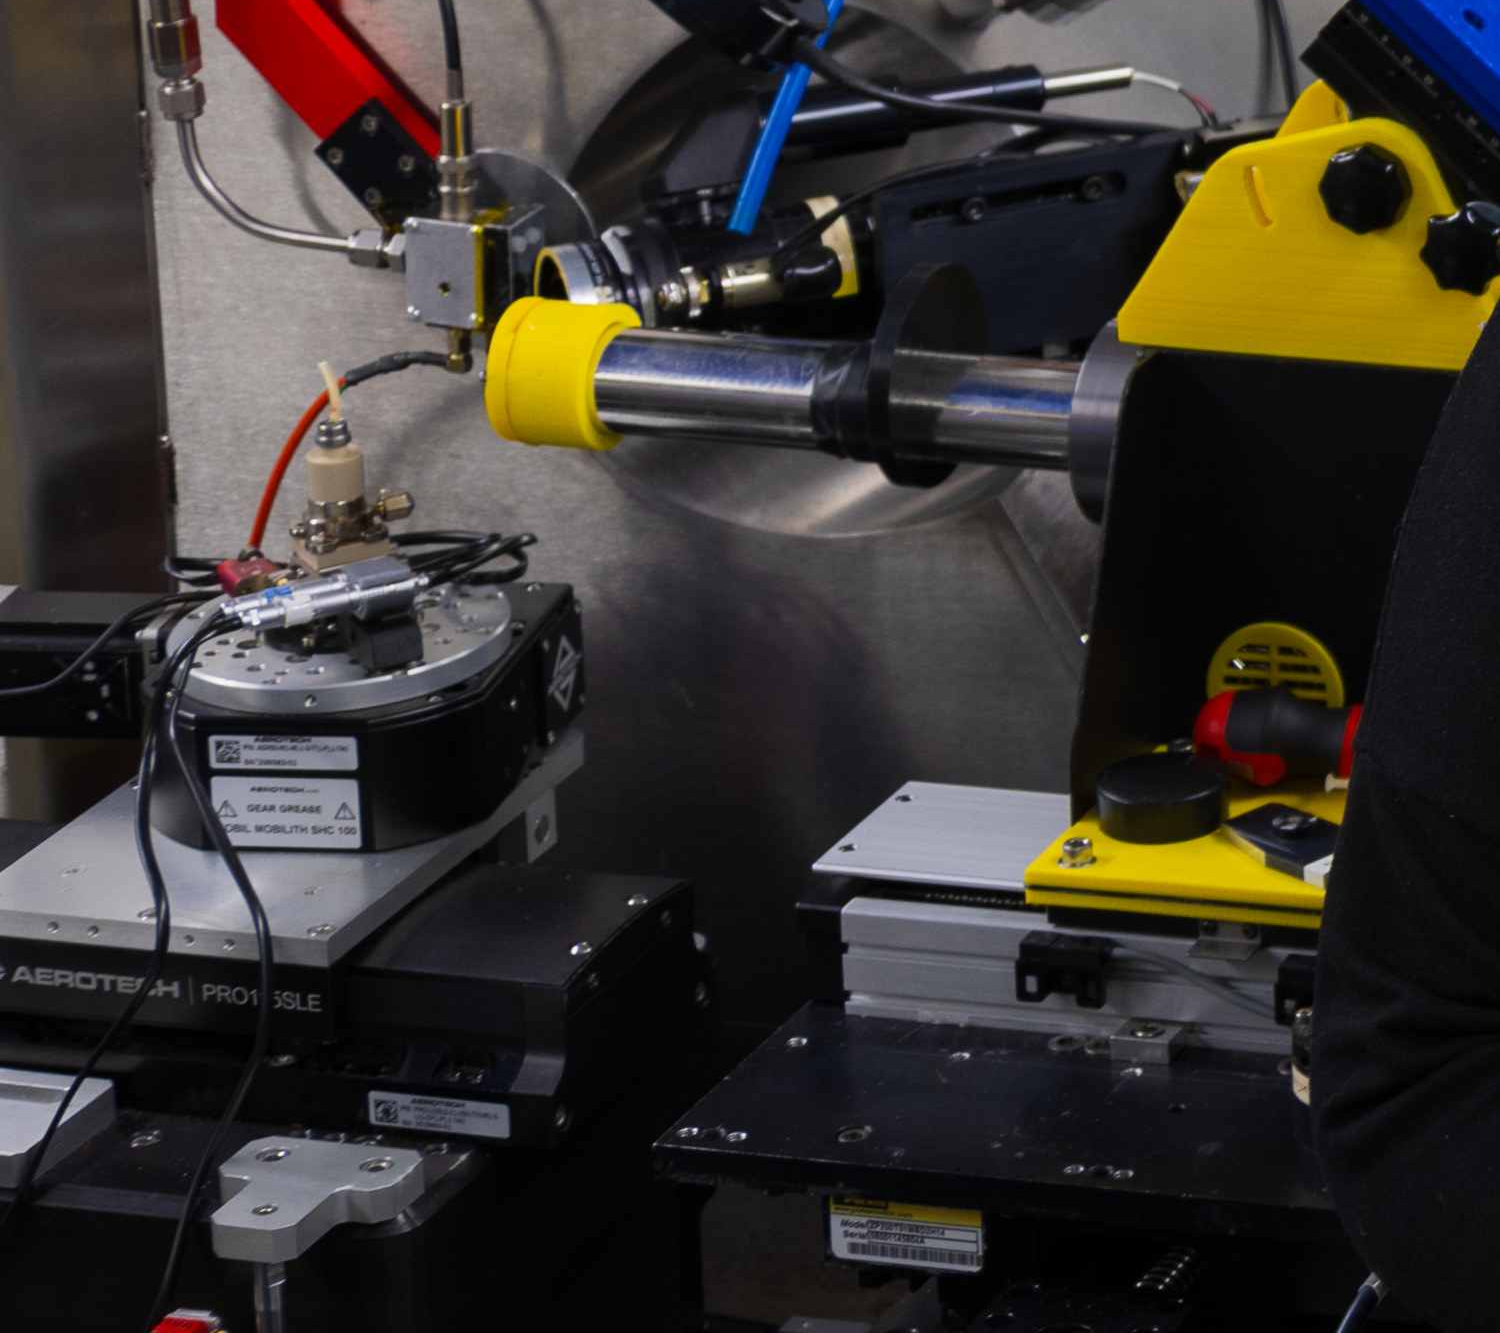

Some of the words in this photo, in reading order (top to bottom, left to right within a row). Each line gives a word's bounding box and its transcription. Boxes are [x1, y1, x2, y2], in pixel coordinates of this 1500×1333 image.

[246, 803, 276, 814] GEAR
[278, 804, 323, 815] GREASE
[224, 823, 252, 834] OBIL
[254, 823, 309, 836] MOBILITH
[311, 825, 336, 836] SHC
[201, 983, 323, 1013] PRO15SLE
